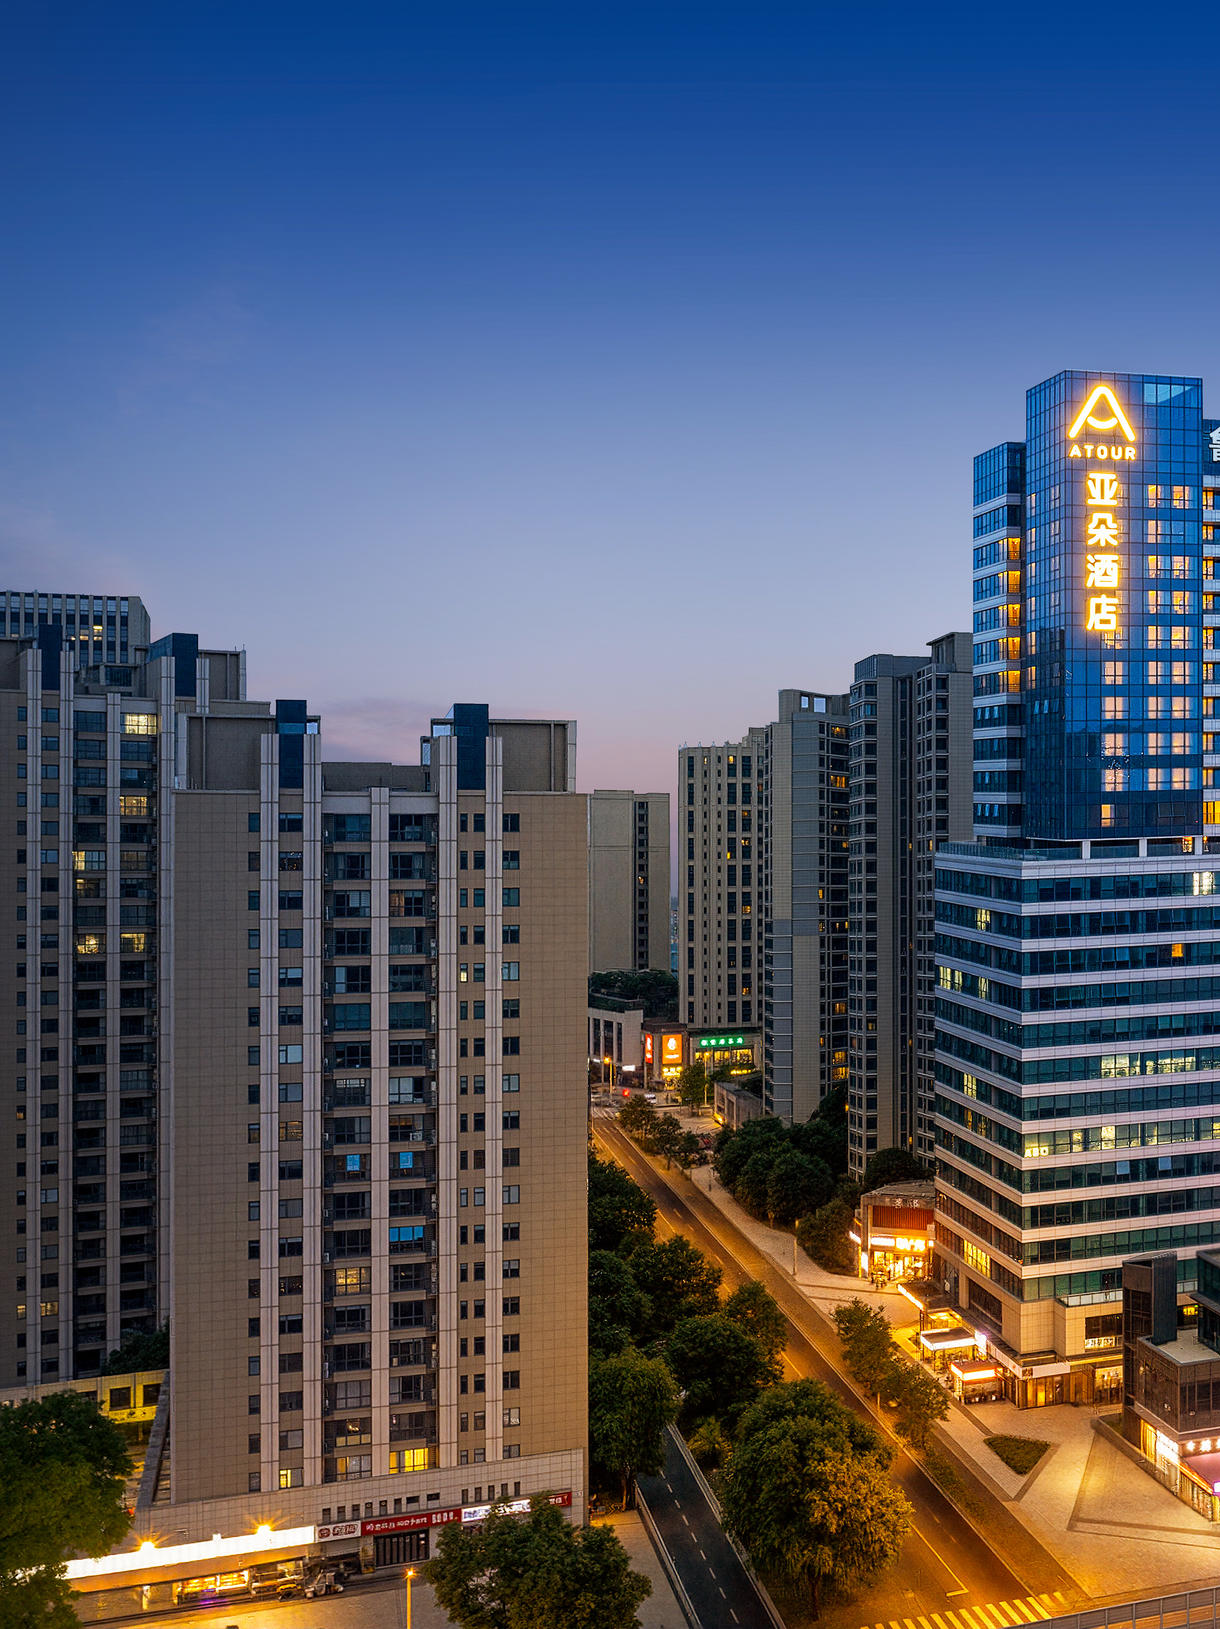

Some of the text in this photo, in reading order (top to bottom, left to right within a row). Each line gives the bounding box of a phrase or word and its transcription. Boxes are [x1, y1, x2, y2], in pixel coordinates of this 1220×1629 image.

[1069, 444, 1136, 460] ATOUR
[1087, 472, 1119, 631] 亚朵酒店
